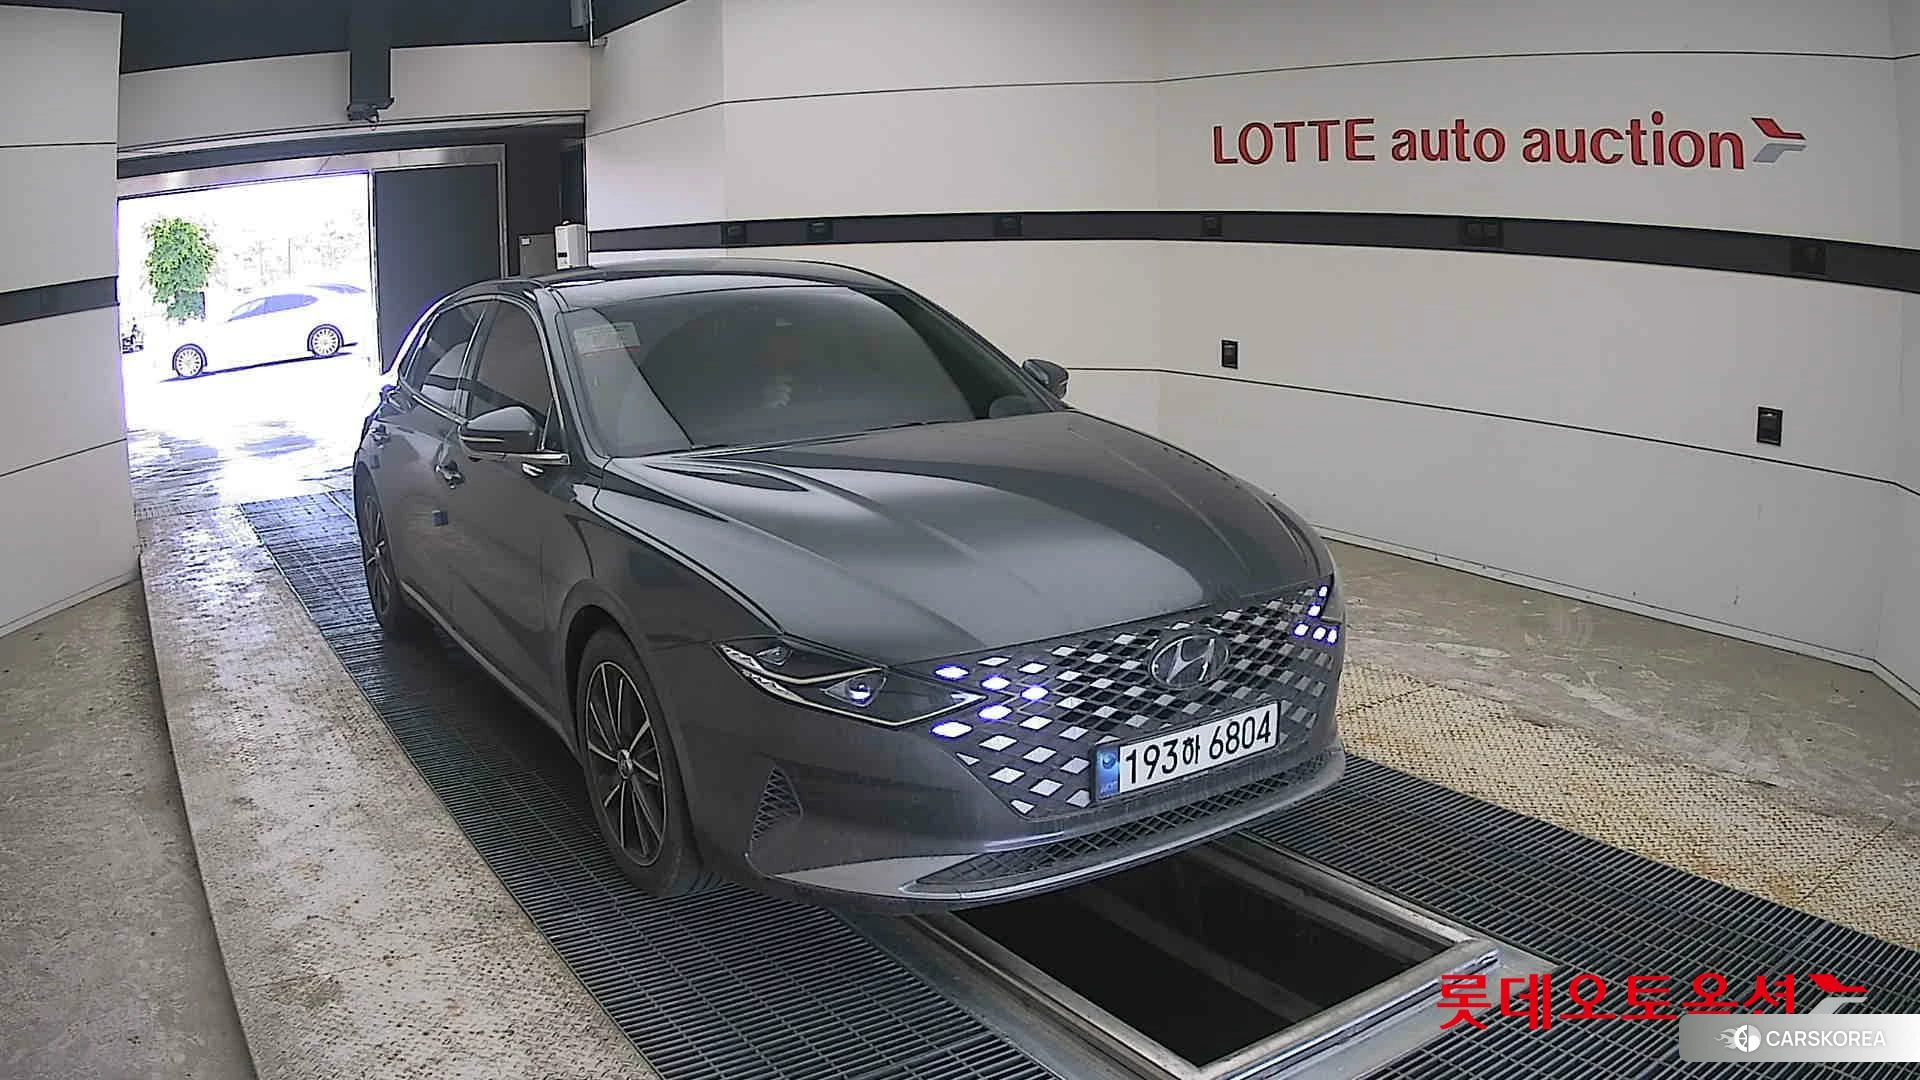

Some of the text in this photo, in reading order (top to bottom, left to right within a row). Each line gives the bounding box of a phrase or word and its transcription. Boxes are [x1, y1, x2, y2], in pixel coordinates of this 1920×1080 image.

[1212, 111, 1745, 170] LOTTE auto auction
[1125, 710, 1272, 784] 193하 6804
